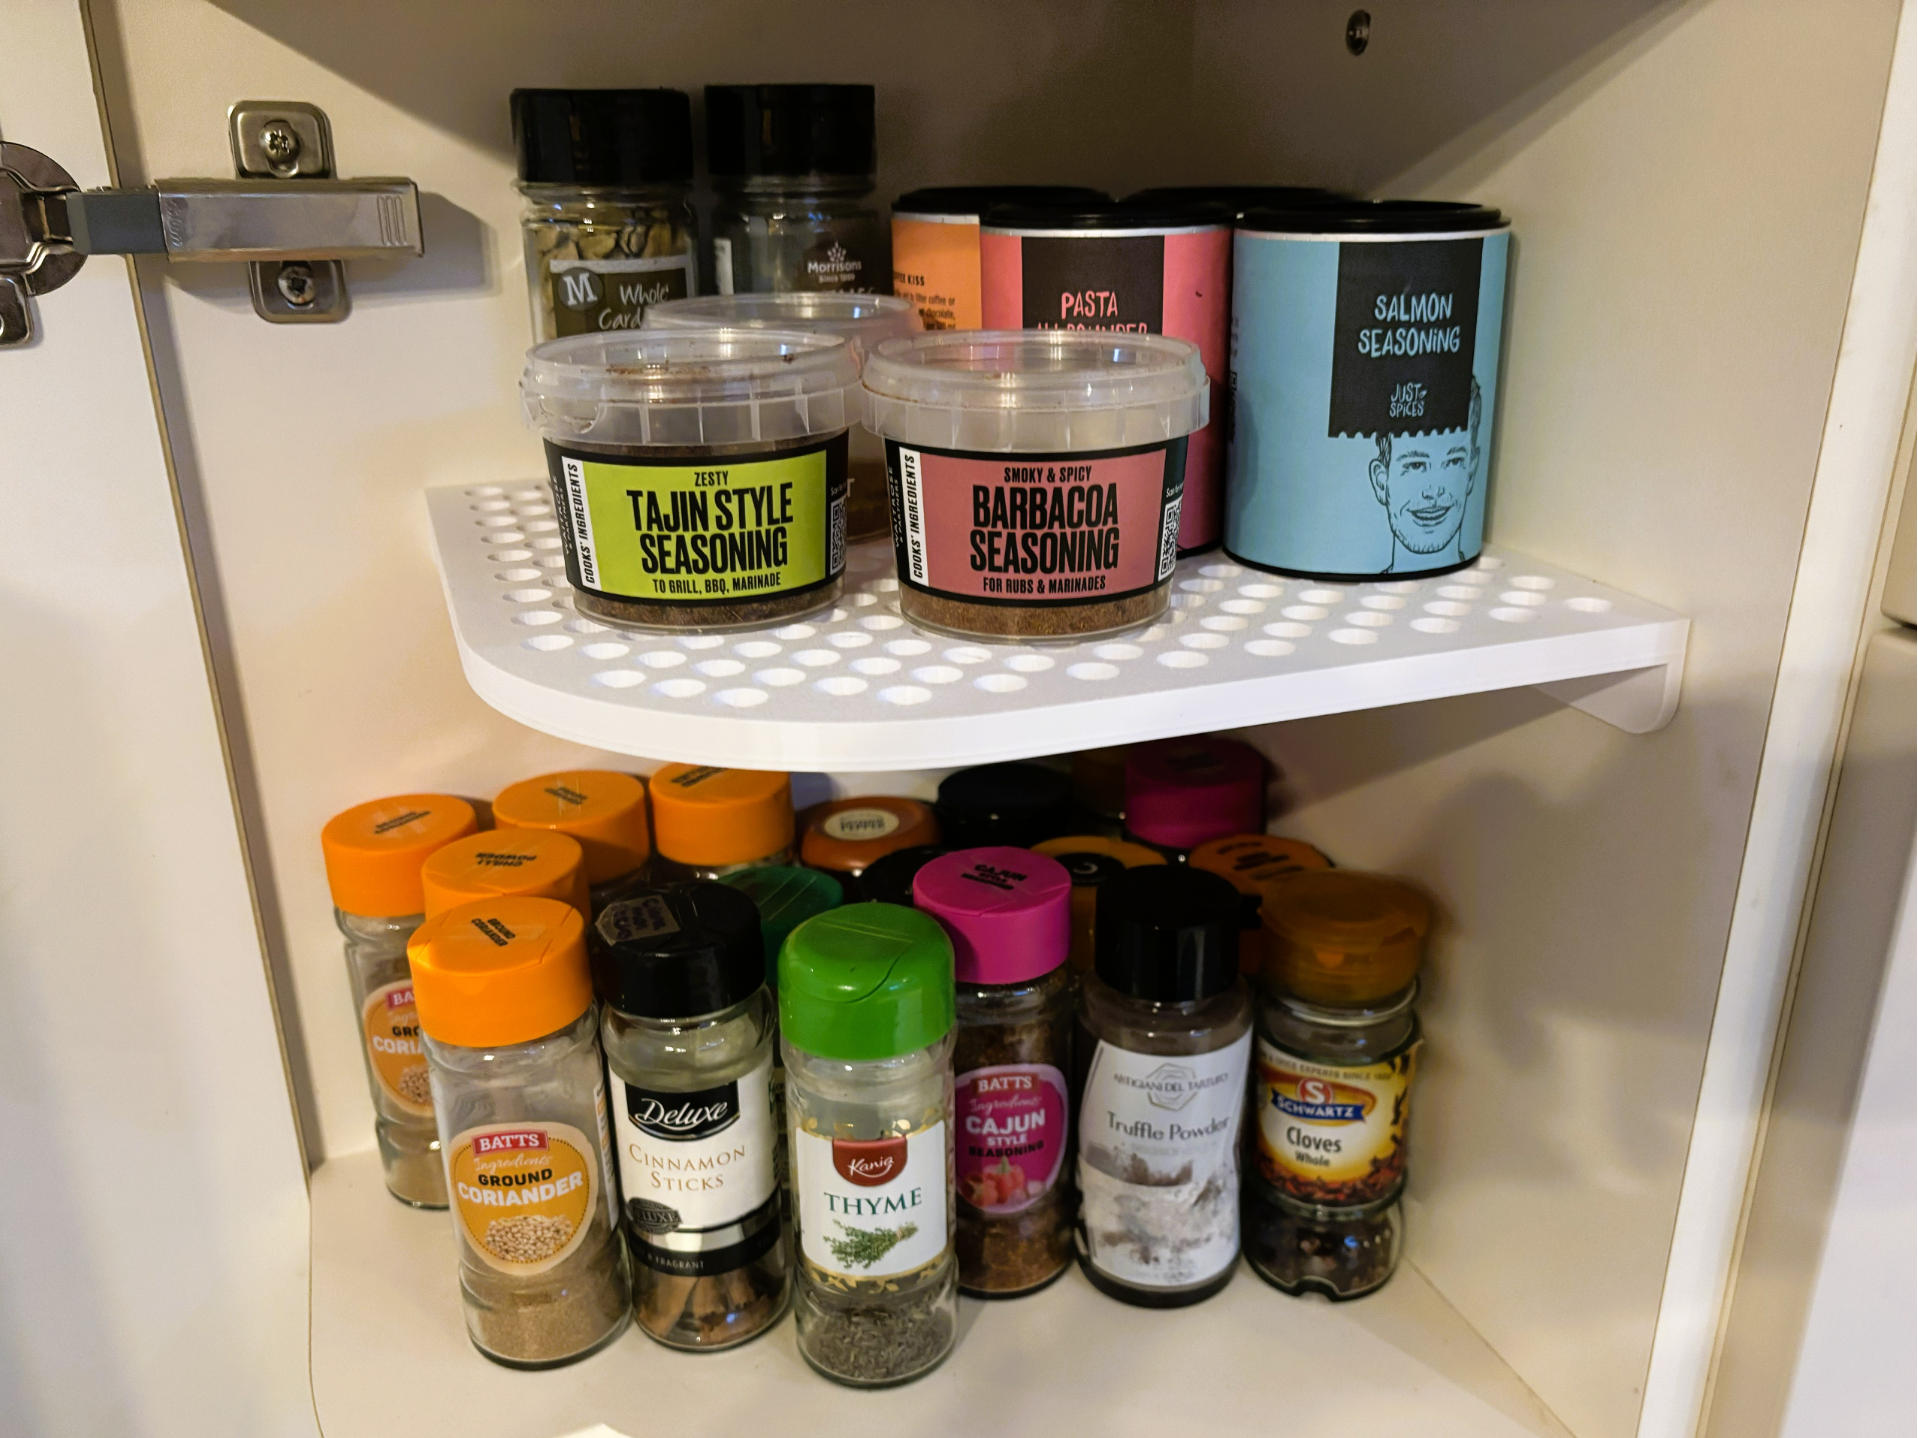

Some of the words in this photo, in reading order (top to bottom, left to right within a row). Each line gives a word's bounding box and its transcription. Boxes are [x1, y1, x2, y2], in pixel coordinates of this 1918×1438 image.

[807, 261, 862, 274] Morrisons
[563, 272, 598, 306] M
[907, 274, 925, 286] KISS
[620, 283, 669, 306] Whole
[1061, 290, 1118, 320] PASTA
[598, 307, 641, 330] Card
[1374, 292, 1453, 324] SALMON
[1391, 383, 1423, 402] JUST
[694, 470, 729, 487] ZESTY
[1004, 467, 1044, 483] SMOKY
[1046, 467, 1056, 482] &
[1059, 465, 1092, 482] SPICY
[568, 463, 589, 540] INGREDIENTS
[904, 454, 921, 533] INGREDIENTS
[626, 489, 712, 532] TAJIN
[714, 482, 793, 532] STYLE
[972, 483, 1118, 531] BARBACOA
[640, 527, 788, 575] SEASONING
[970, 527, 1120, 575] SEASONING
[653, 578, 666, 594] TO
[669, 578, 702, 595] GRILL,
[732, 572, 781, 591] MARINADE
[983, 577, 1002, 592] FOR
[1005, 578, 1034, 594] RUBS
[1037, 579, 1045, 594] &
[1048, 575, 1106, 594] MARINADES
[393, 991, 415, 1006] BA
[978, 1076, 1032, 1092] BATTS
[1304, 1081, 1325, 1105] S
[635, 1098, 728, 1131] Deluxe
[1277, 1095, 1354, 1118] SCHWARTZ
[965, 1108, 1045, 1135] CAJUN
[1107, 1110, 1164, 1140] Truffle
[1169, 1117, 1230, 1140] Powder
[480, 1134, 540, 1151] BATTS
[968, 1140, 1044, 1157] SEASONING
[987, 1134, 1028, 1147] STYLE
[1286, 1126, 1342, 1152] Cloves
[474, 1153, 552, 1174] Ingredients
[629, 1143, 745, 1171] CINNAMON
[1295, 1151, 1330, 1167] Whole
[457, 1170, 583, 1207] CORIANDER
[478, 1168, 553, 1187] GROUND
[651, 1171, 724, 1191] STICKS
[824, 1187, 922, 1216] THYME
